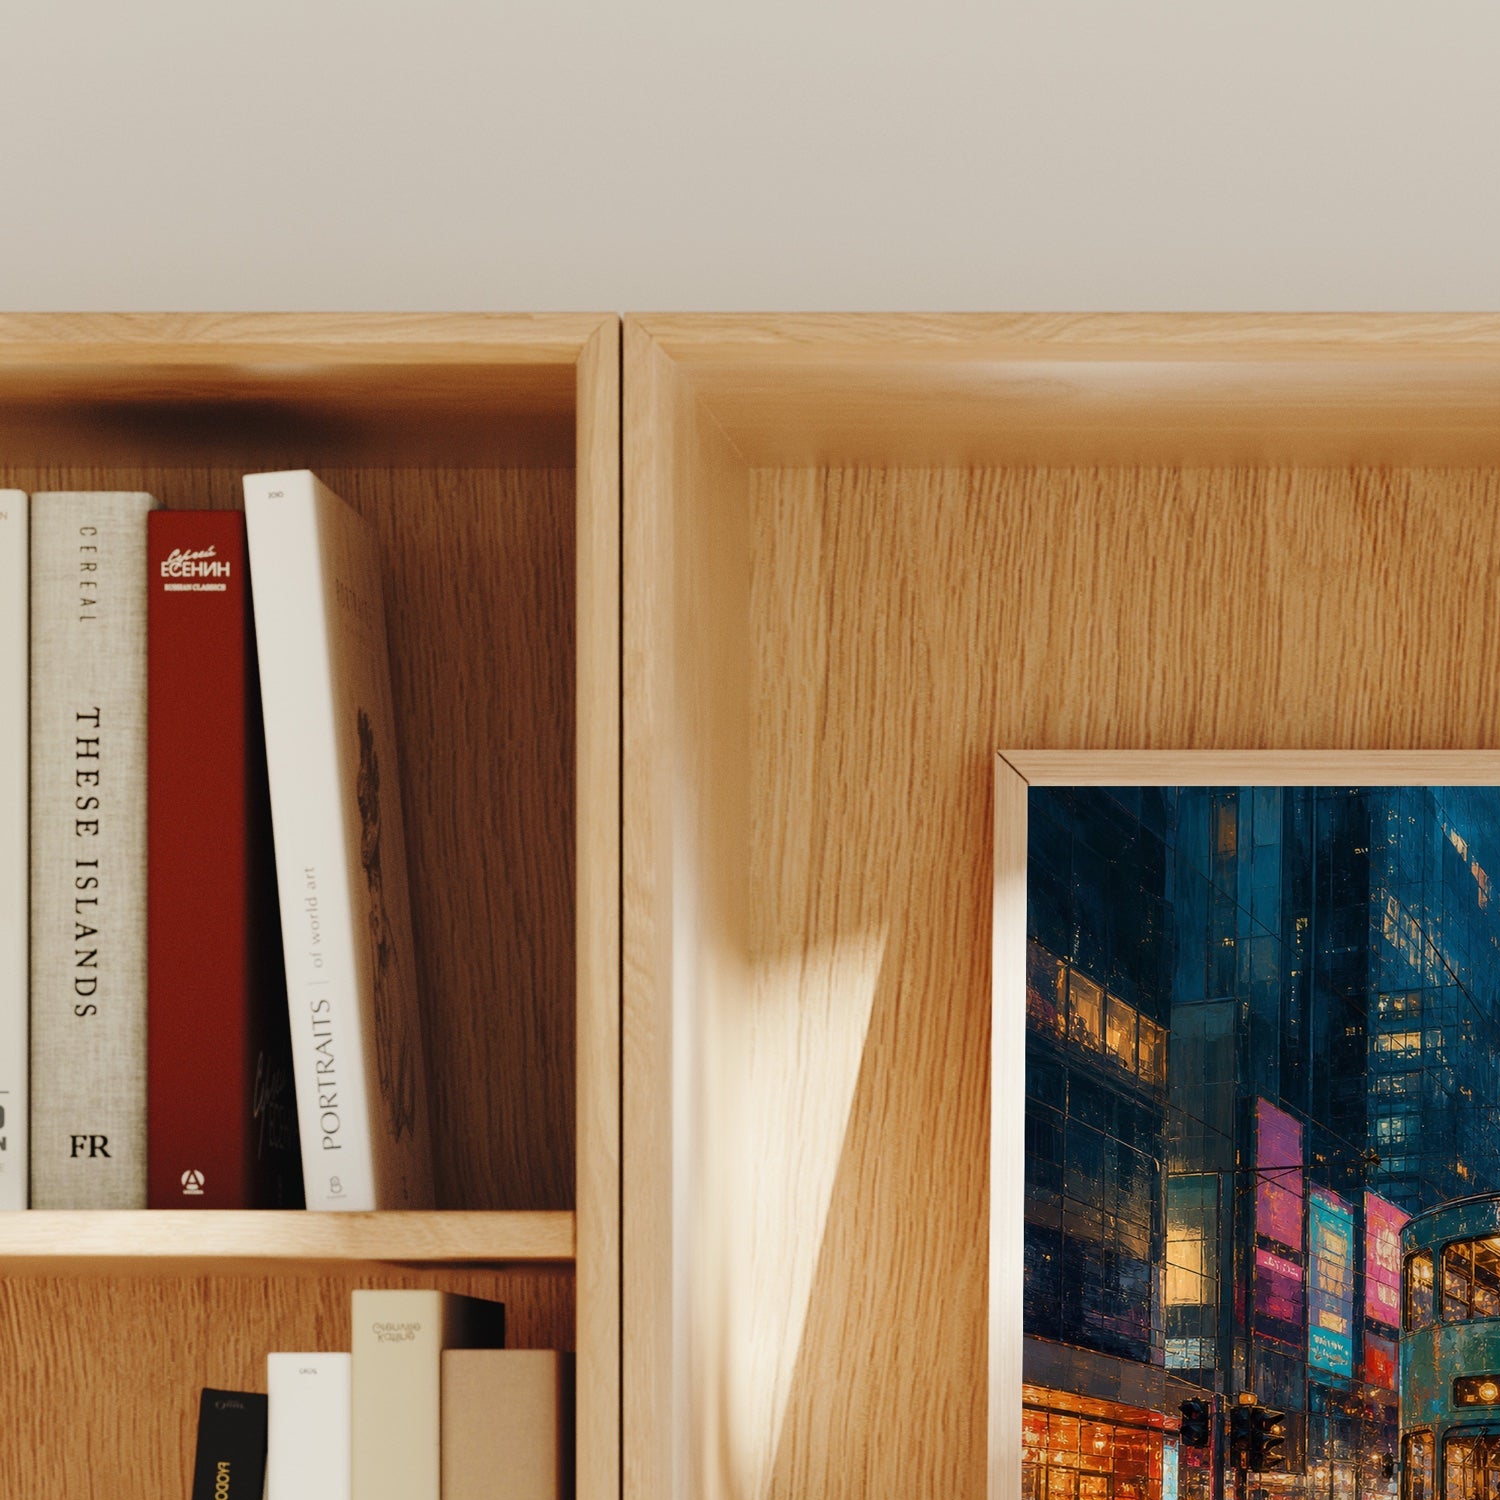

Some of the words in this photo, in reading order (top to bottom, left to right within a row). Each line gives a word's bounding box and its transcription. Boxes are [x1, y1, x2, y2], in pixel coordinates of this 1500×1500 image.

[79, 526, 98, 622] CEREAL
[161, 561, 231, 577] ЕСЕНИН
[76, 707, 101, 837] THESE
[304, 866, 317, 889] art
[74, 859, 99, 1017] ISLANDS
[304, 896, 321, 946] world
[314, 950, 324, 969] of
[310, 999, 342, 1151] PORTRAITS
[70, 1134, 112, 1158] FR
